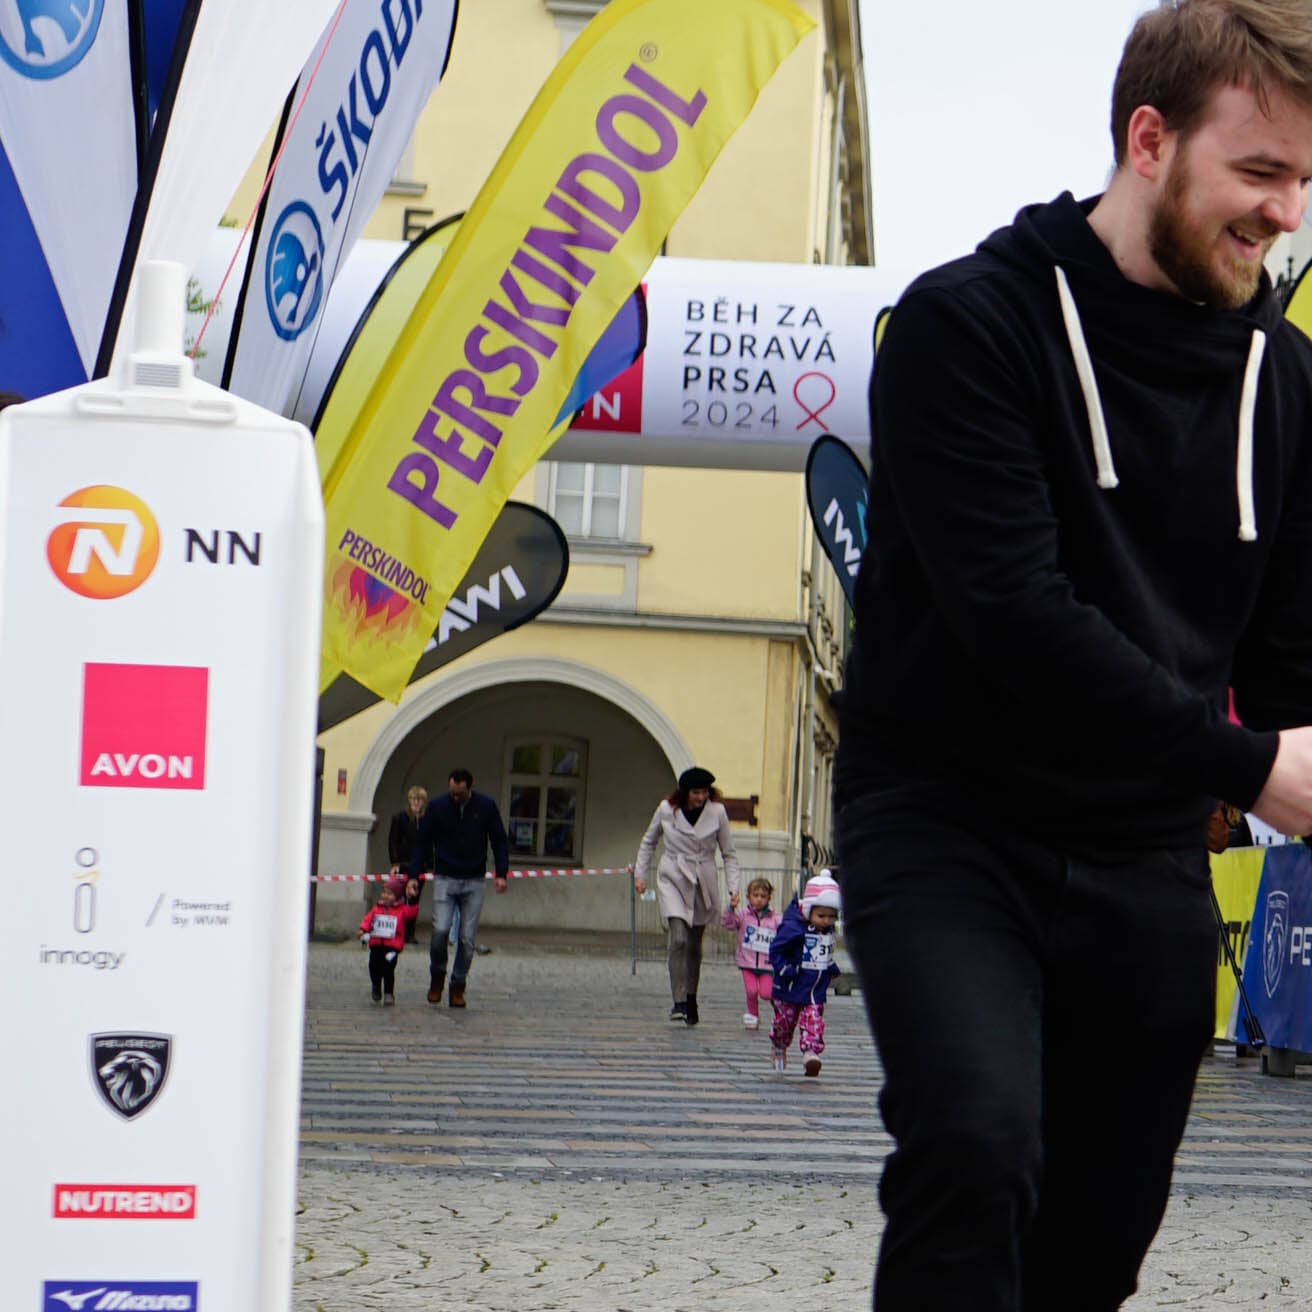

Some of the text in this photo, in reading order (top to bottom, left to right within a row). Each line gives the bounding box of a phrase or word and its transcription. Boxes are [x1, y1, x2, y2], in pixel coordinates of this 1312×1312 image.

[386, 63, 708, 530] PERSKINDOL
[686, 296, 823, 328] BĚH ZA
[683, 330, 837, 363] ZDRAVÁ
[683, 365, 777, 395] PRSA
[681, 399, 781, 431] 2024
[184, 528, 262, 566] NN
[338, 528, 431, 606] PERSKINDOL
[424, 565, 527, 652] AWI
[90, 753, 193, 779] AVON
[39, 944, 126, 969] innogy
[58, 1191, 193, 1214] NUTREND
